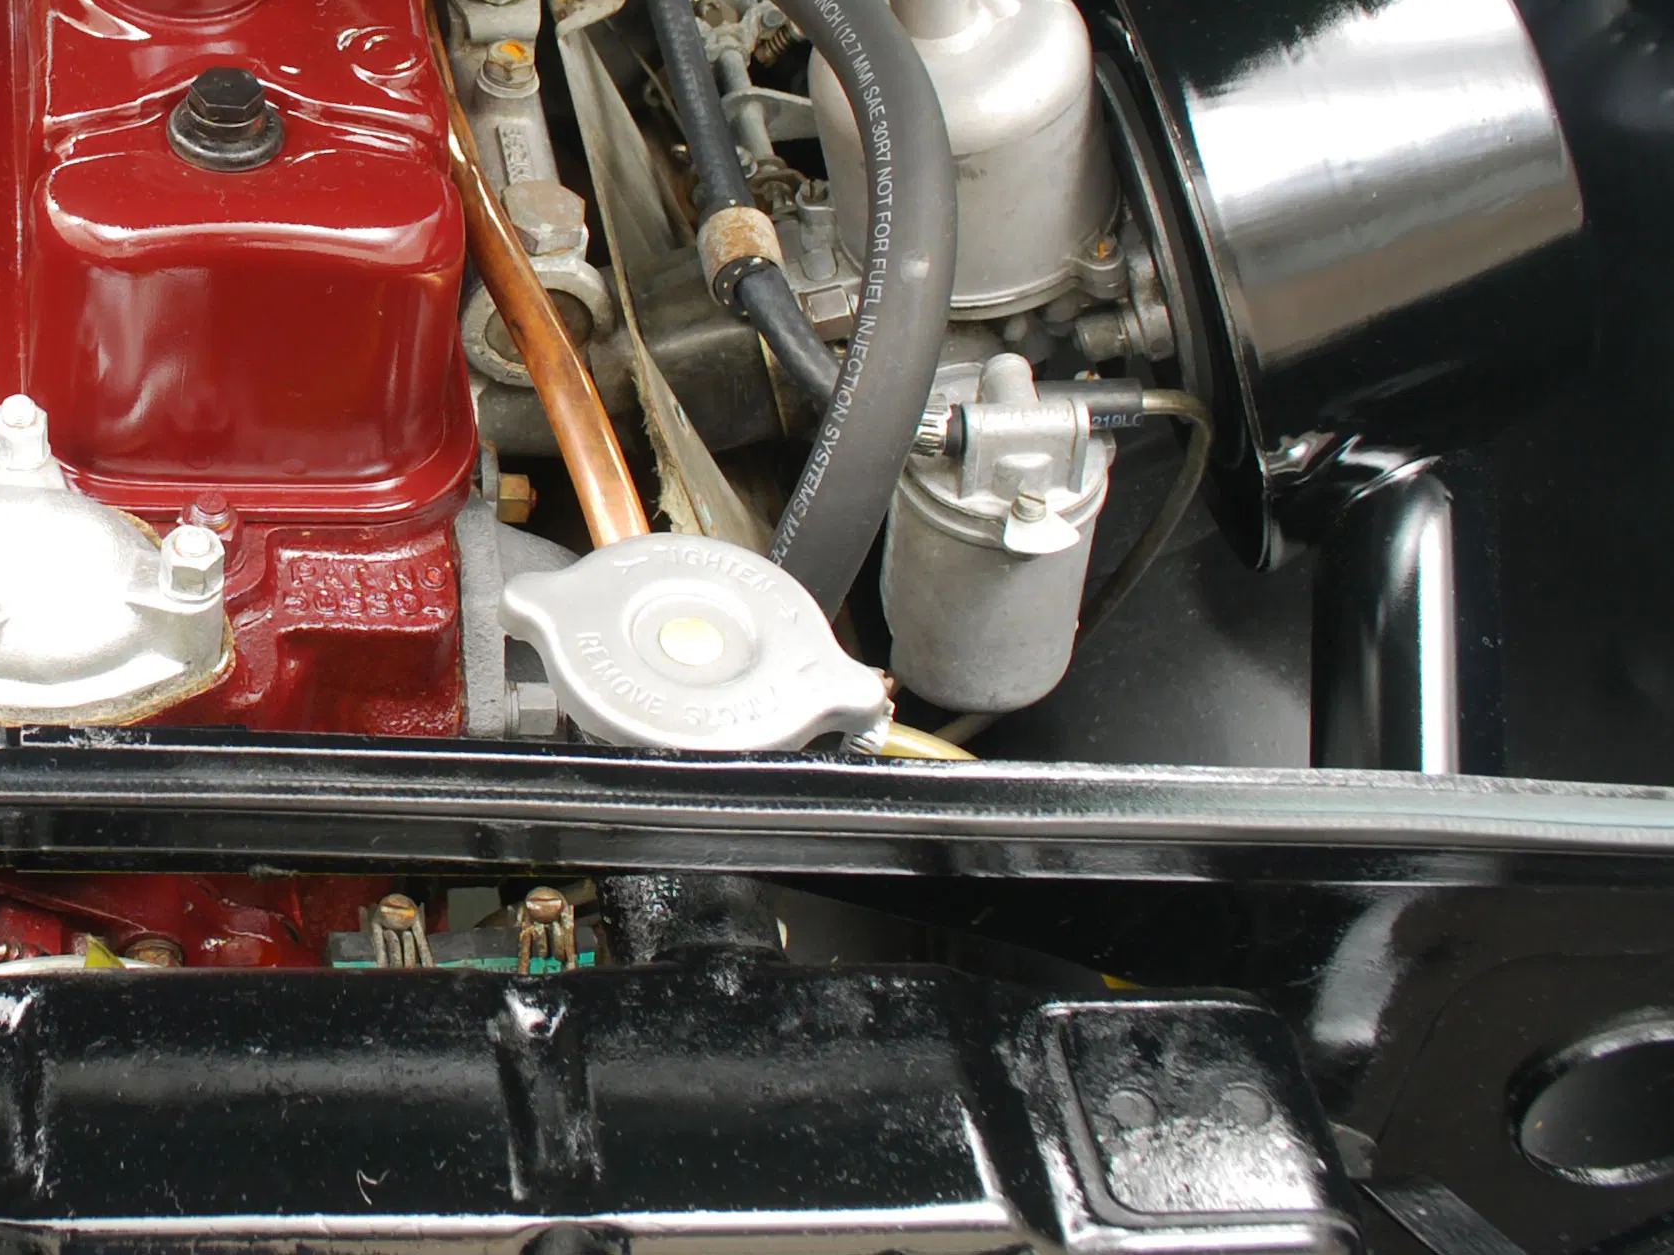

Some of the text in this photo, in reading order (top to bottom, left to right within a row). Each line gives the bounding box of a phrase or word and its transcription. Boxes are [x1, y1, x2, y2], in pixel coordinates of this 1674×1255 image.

[852, 52, 876, 89] MM)
[862, 85, 886, 122] SAE
[872, 121, 891, 161] 30R7
[876, 166, 893, 207] NOT
[873, 211, 892, 252] FOR
[863, 258, 887, 308] FUEL
[831, 314, 877, 423] INJECTION
[792, 423, 840, 519] SYSTEMS
[769, 512, 801, 567] MADE
[576, 630, 668, 715] REMOVE
